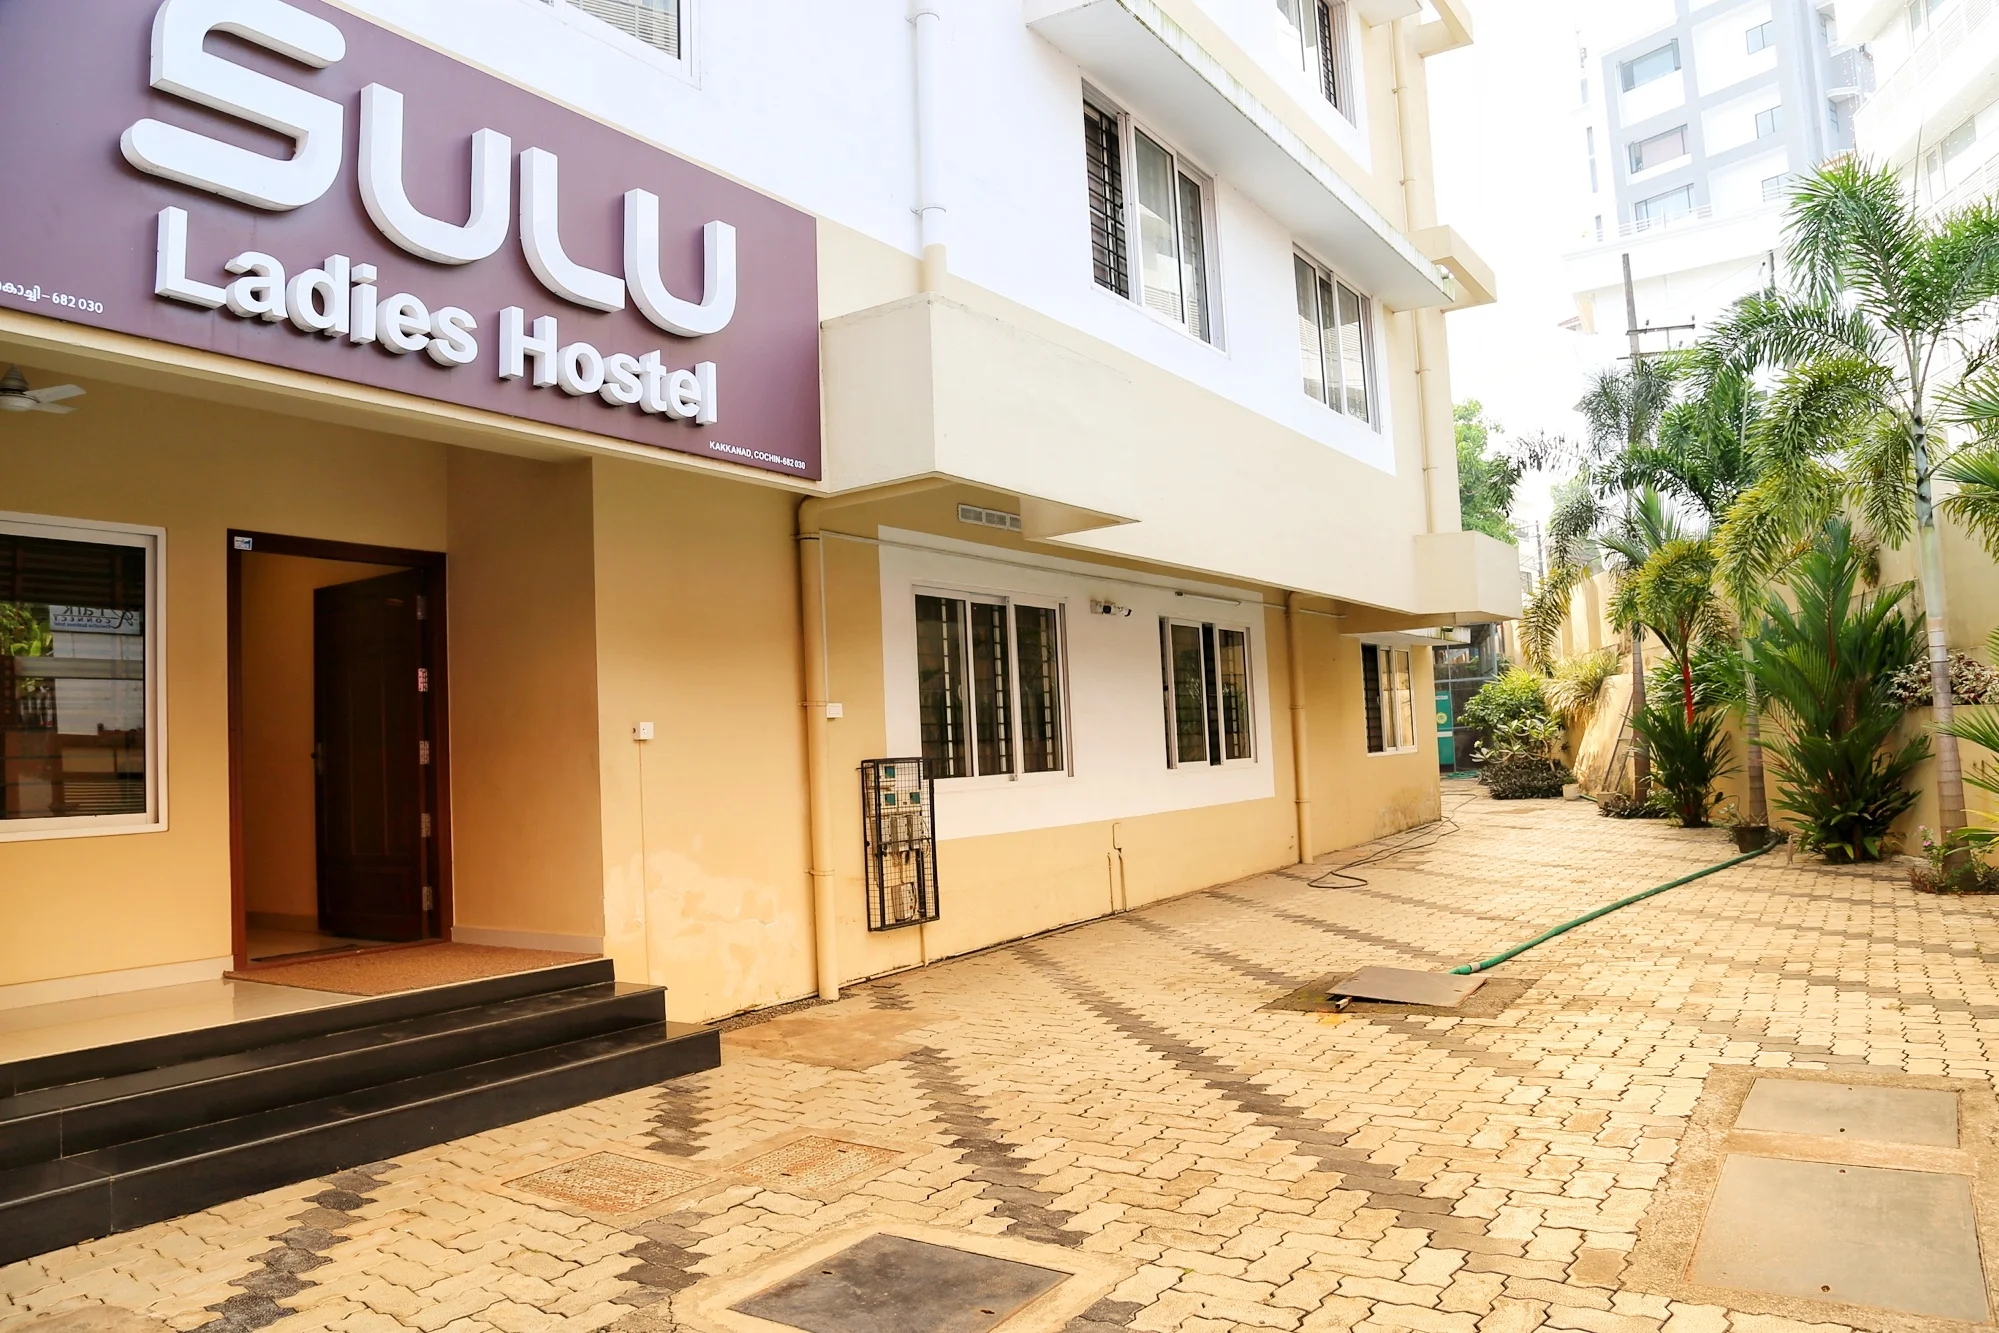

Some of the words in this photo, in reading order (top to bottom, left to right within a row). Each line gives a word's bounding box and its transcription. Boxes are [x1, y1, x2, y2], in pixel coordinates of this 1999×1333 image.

[120, 0, 737, 338] SULU
[78, 298, 104, 314] 030
[155, 206, 478, 367] Ladies
[499, 305, 717, 425] Hostel
[709, 440, 754, 459] KAKKANAD,
[795, 460, 806, 470] 030
